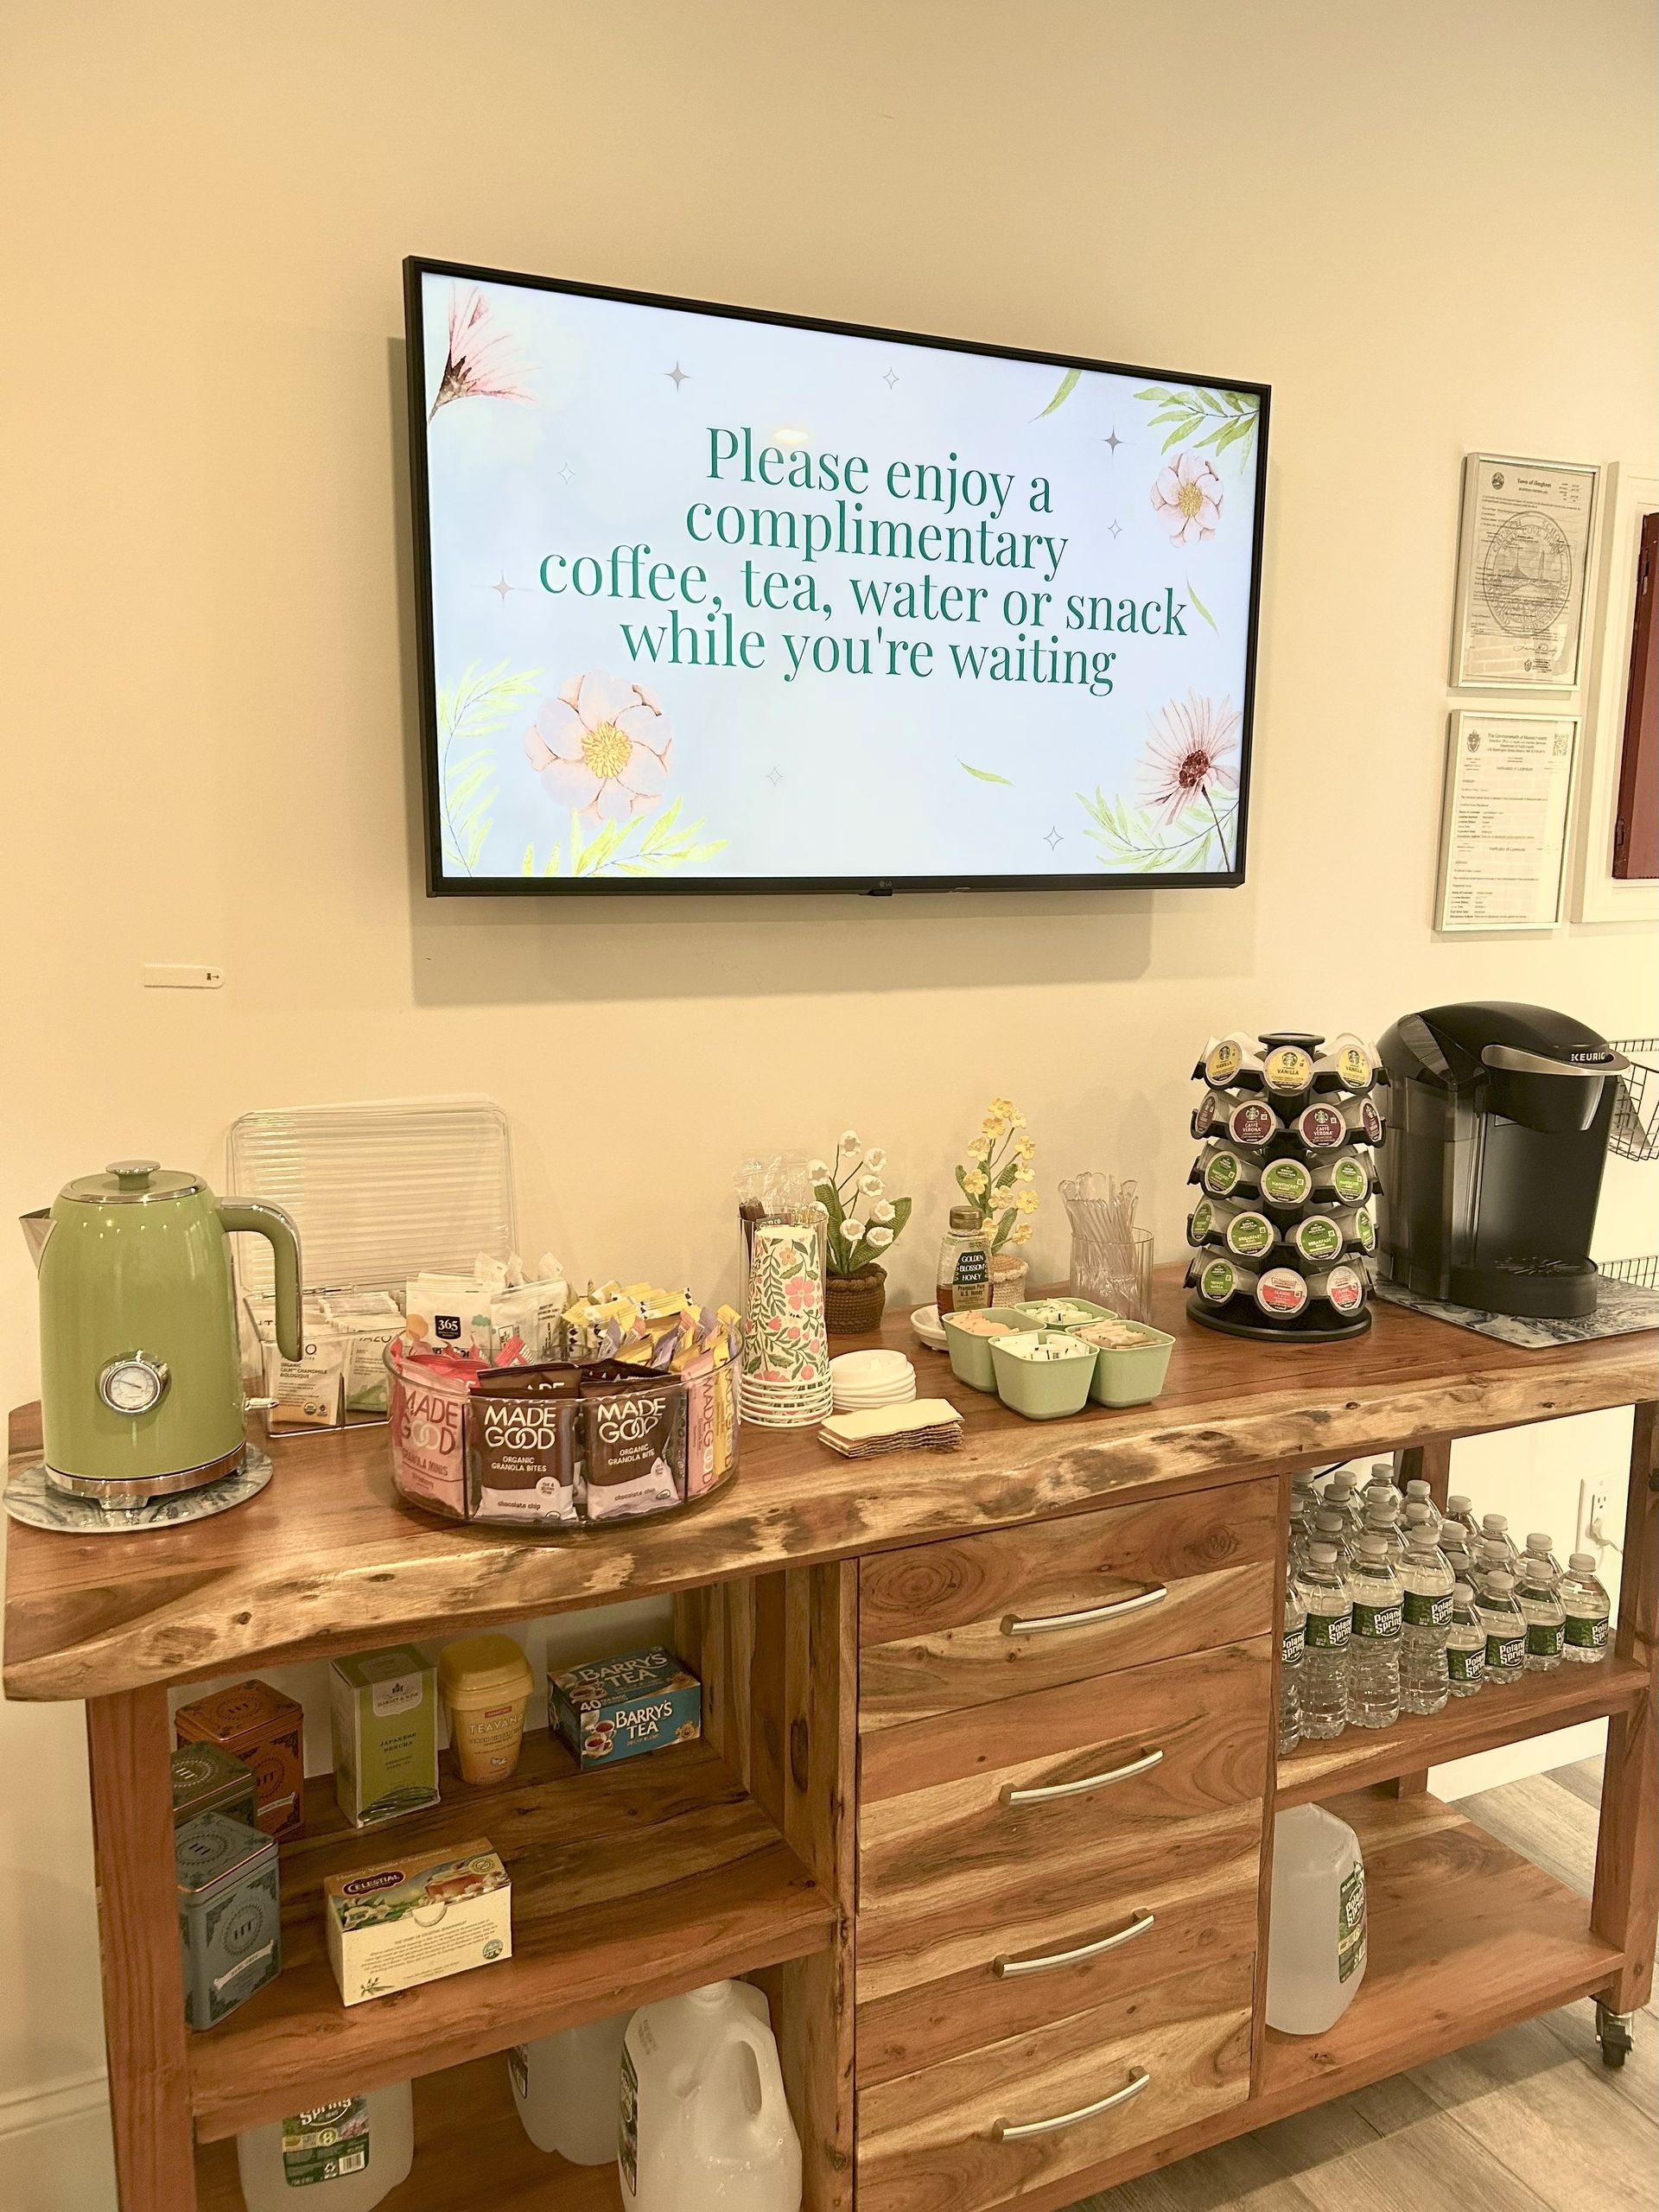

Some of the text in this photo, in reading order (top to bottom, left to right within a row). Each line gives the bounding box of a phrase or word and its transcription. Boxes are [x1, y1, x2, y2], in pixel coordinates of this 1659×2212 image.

[707, 427, 1053, 517] Please enjoy a
[686, 499, 1069, 582] complimentary
[539, 544, 1188, 636] coffee, tea, water or snack
[619, 610, 1117, 697] while you're waiting
[1571, 1052, 1605, 1062] KEURIG
[959, 1263, 985, 1272] BLOSSOM
[961, 1255, 984, 1263] GOLDEN
[962, 1273, 982, 1281] HONEY
[437, 1319, 459, 1331] 365
[484, 1405, 557, 1427] MADE
[598, 1397, 666, 1422] MADE
[485, 1426, 556, 1450] GOOD
[607, 1452, 641, 1466] GRANOLA
[620, 1443, 650, 1457] ORGANIC
[491, 1462, 547, 1472] GRANOLA BITES
[503, 1455, 536, 1464] ORGANIC
[579, 1653, 668, 1682] BARRY'S
[605, 1669, 658, 1688] TEA
[581, 1700, 602, 1711] 40
[615, 1700, 672, 1729] BARRY'S
[626, 1721, 658, 1739] TEA
[347, 1873, 400, 1892] CELESTIAL
